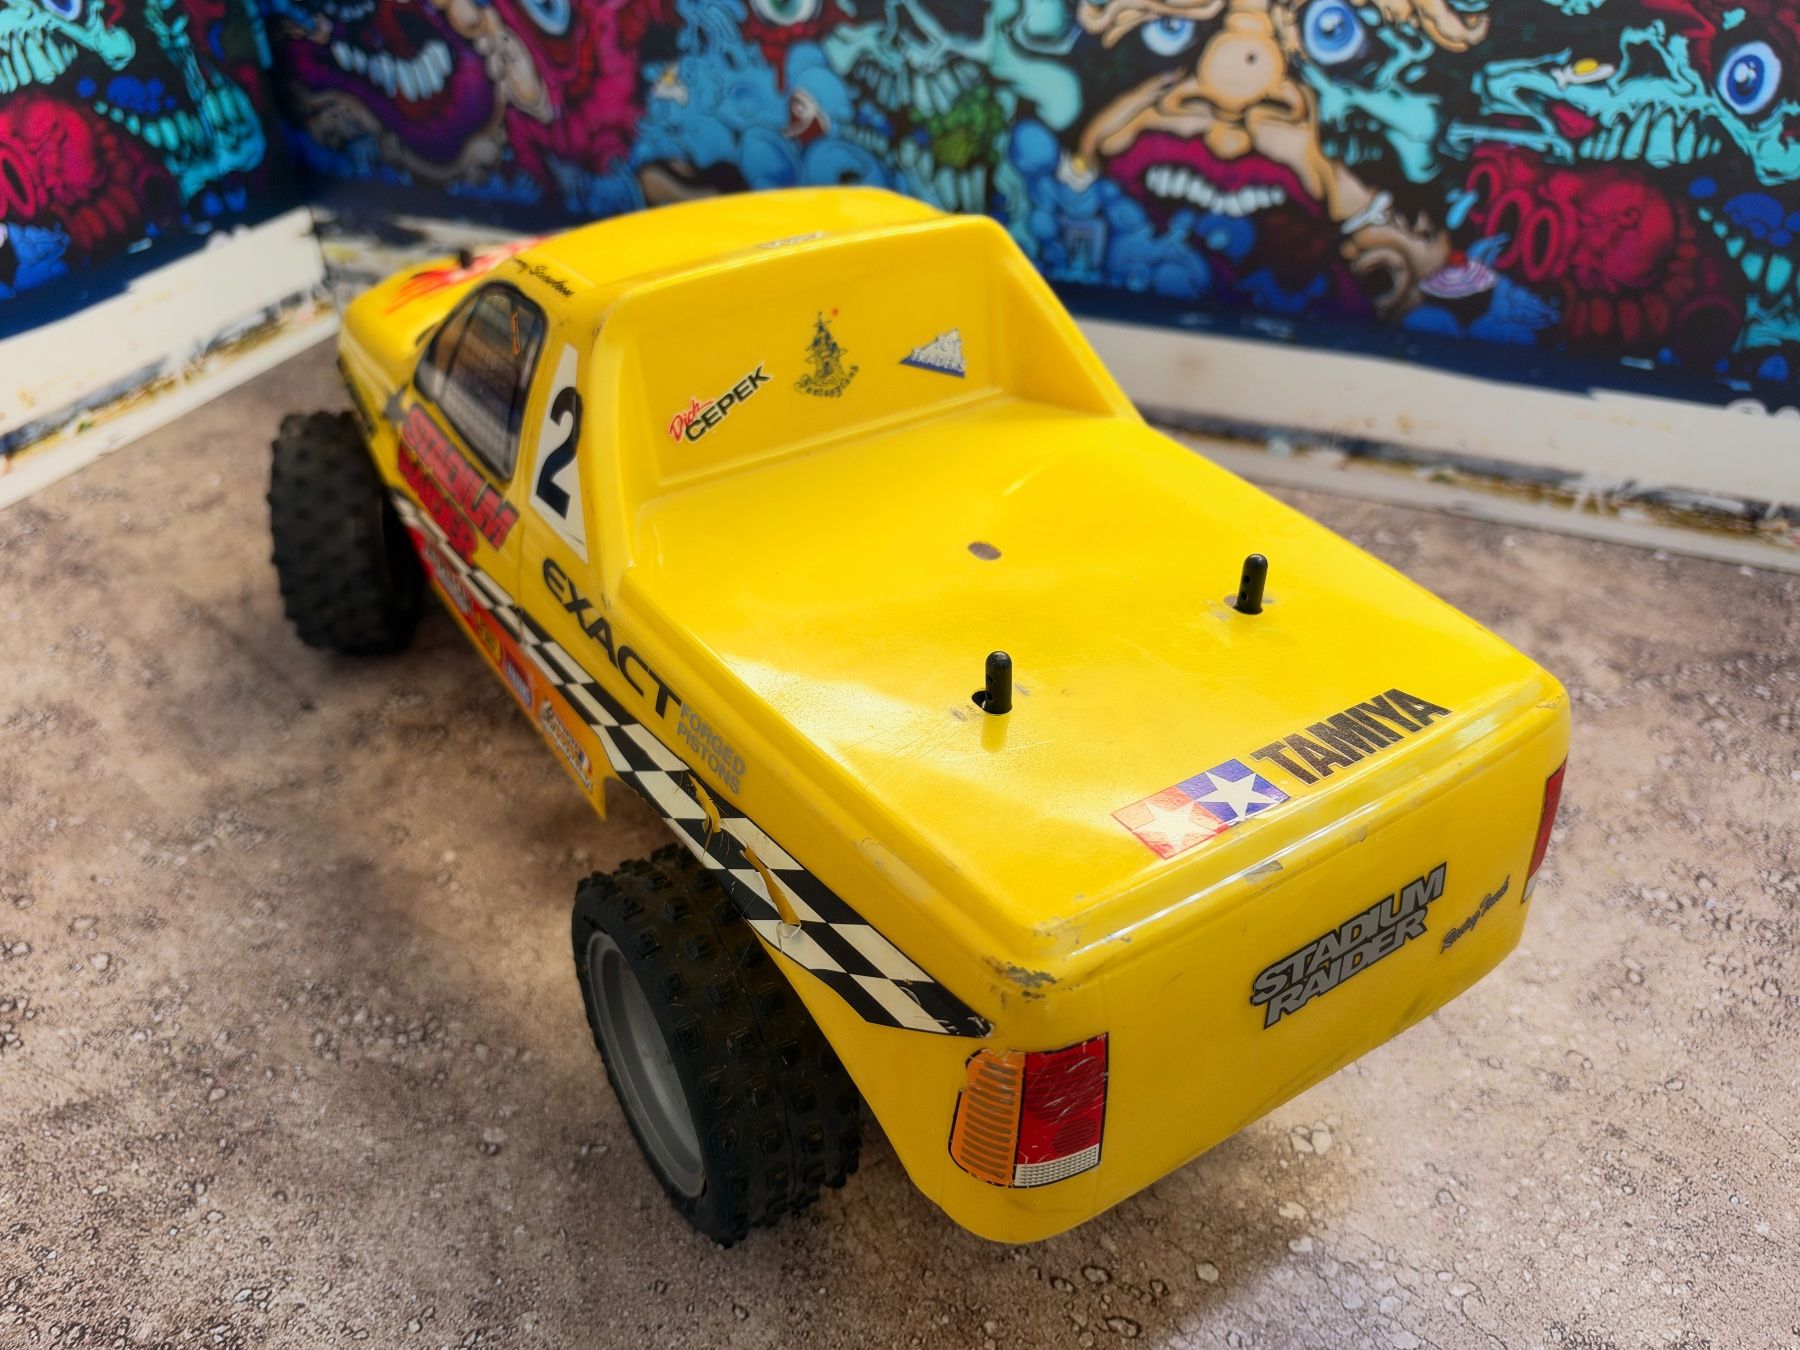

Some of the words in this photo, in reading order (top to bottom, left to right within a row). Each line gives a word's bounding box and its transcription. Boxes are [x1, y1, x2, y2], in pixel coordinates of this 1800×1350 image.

[536, 386, 583, 520] 2
[685, 365, 770, 442] CEPEK
[543, 558, 682, 719] EXACT
[676, 721, 741, 795] PISTONS
[680, 701, 746, 777] FORGED
[1250, 688, 1453, 785] TAMIYA
[1250, 861, 1447, 1006] STADIUM
[1264, 906, 1428, 1030] RAIDER
